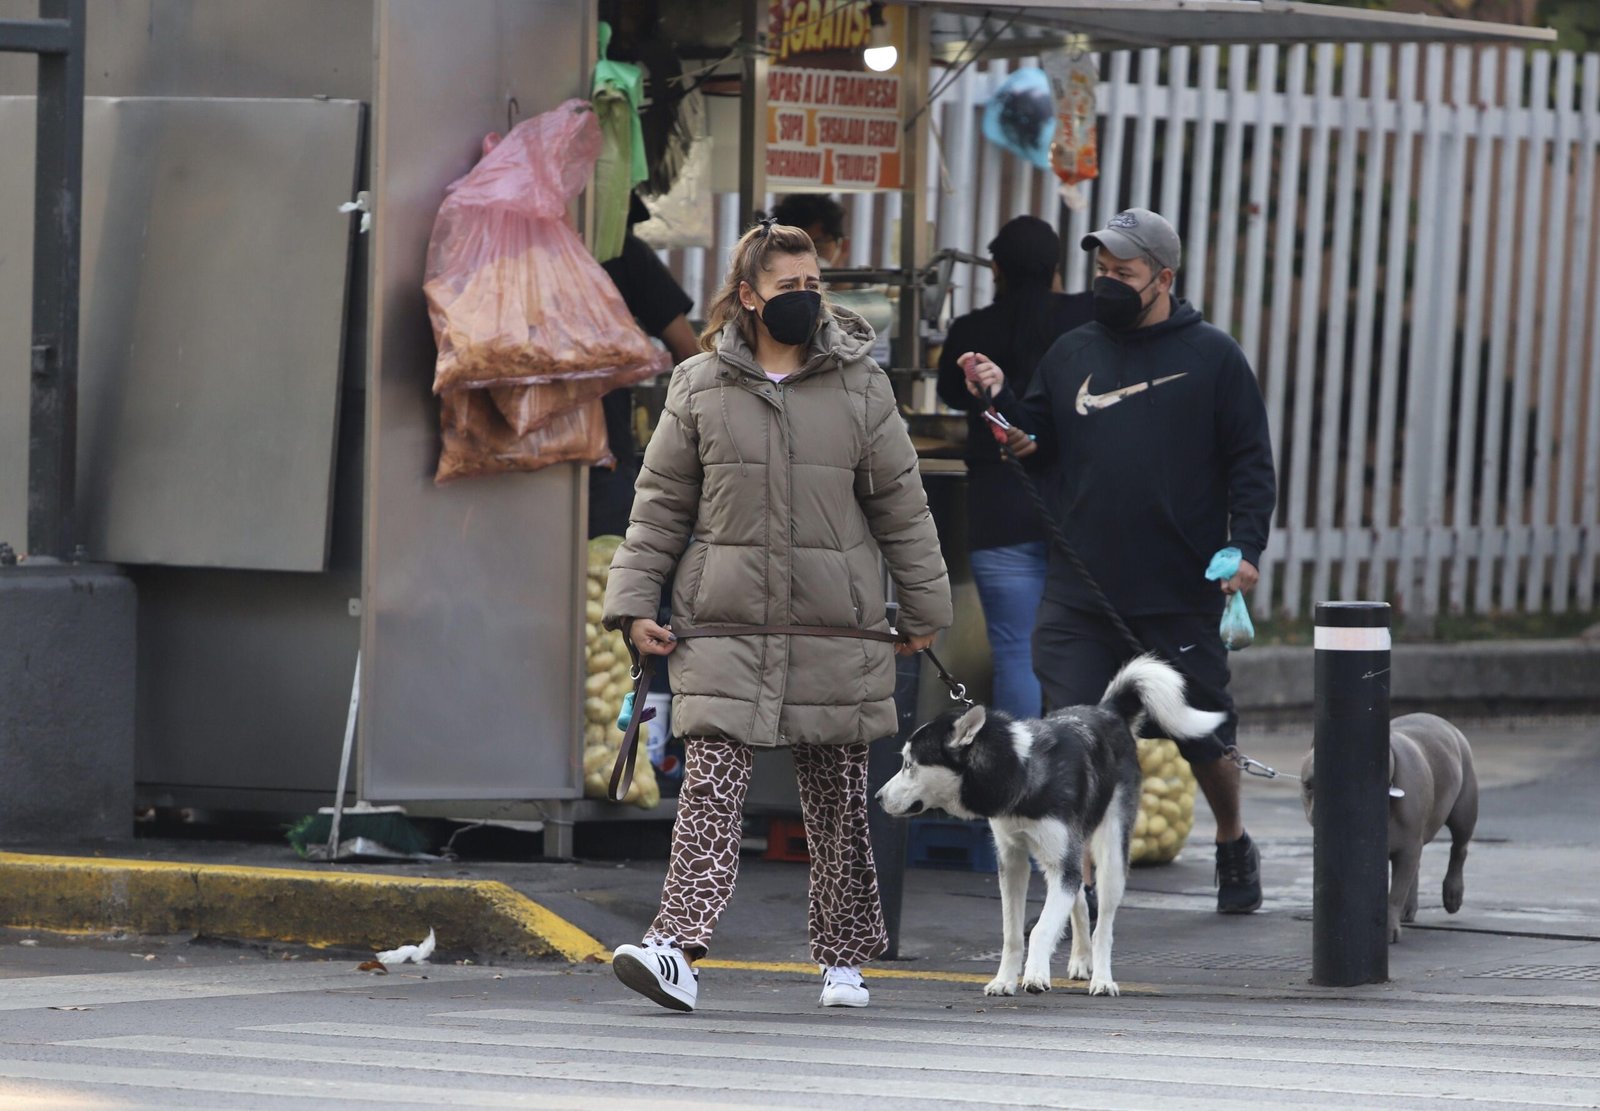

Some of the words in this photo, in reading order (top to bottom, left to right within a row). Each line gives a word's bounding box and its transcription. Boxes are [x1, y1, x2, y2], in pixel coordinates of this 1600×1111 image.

[803, 73, 813, 104] A
[814, 74, 830, 105] LA
[832, 76, 898, 109] FRANCESA
